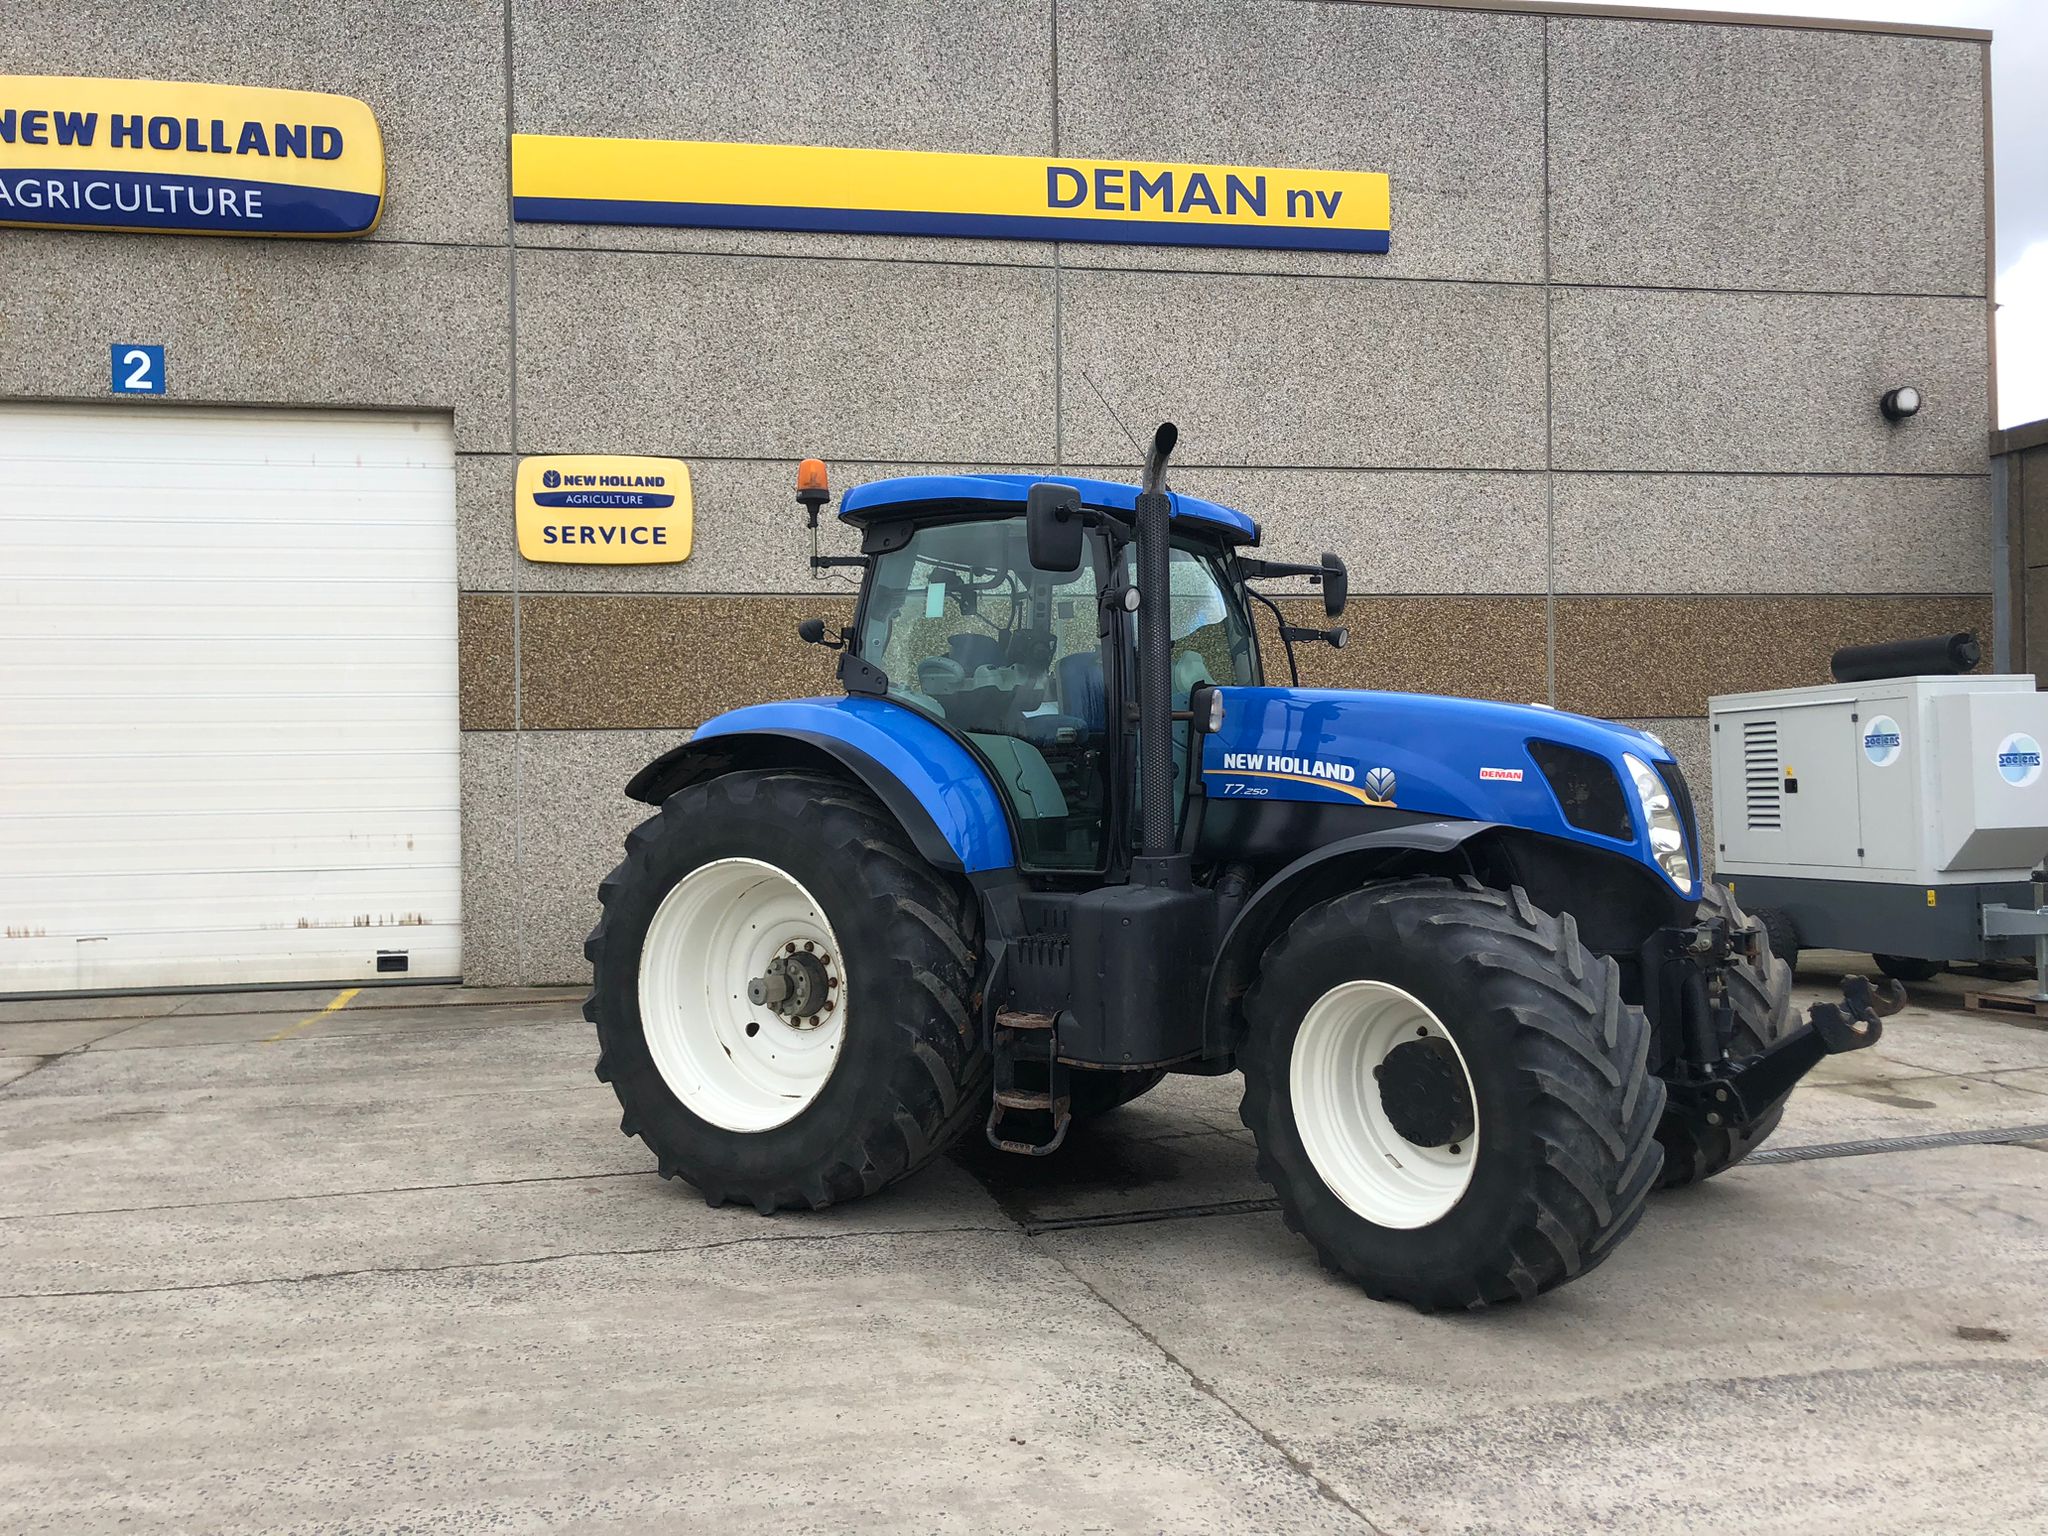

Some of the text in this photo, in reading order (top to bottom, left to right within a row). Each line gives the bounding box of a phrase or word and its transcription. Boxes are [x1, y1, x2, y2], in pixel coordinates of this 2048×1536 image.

[0, 109, 344, 160] NEW HOLLAND
[0, 178, 264, 219] AGRICULTURE
[1046, 166, 1343, 219] DEMAN nv
[123, 349, 153, 390] 2
[564, 475, 665, 488] NEW HOLLAND
[566, 495, 643, 505] AGRICULTURE
[543, 526, 667, 545] SERVICE
[1224, 753, 1355, 782] NEW HOLLAND
[1481, 770, 1522, 780] DEMAN
